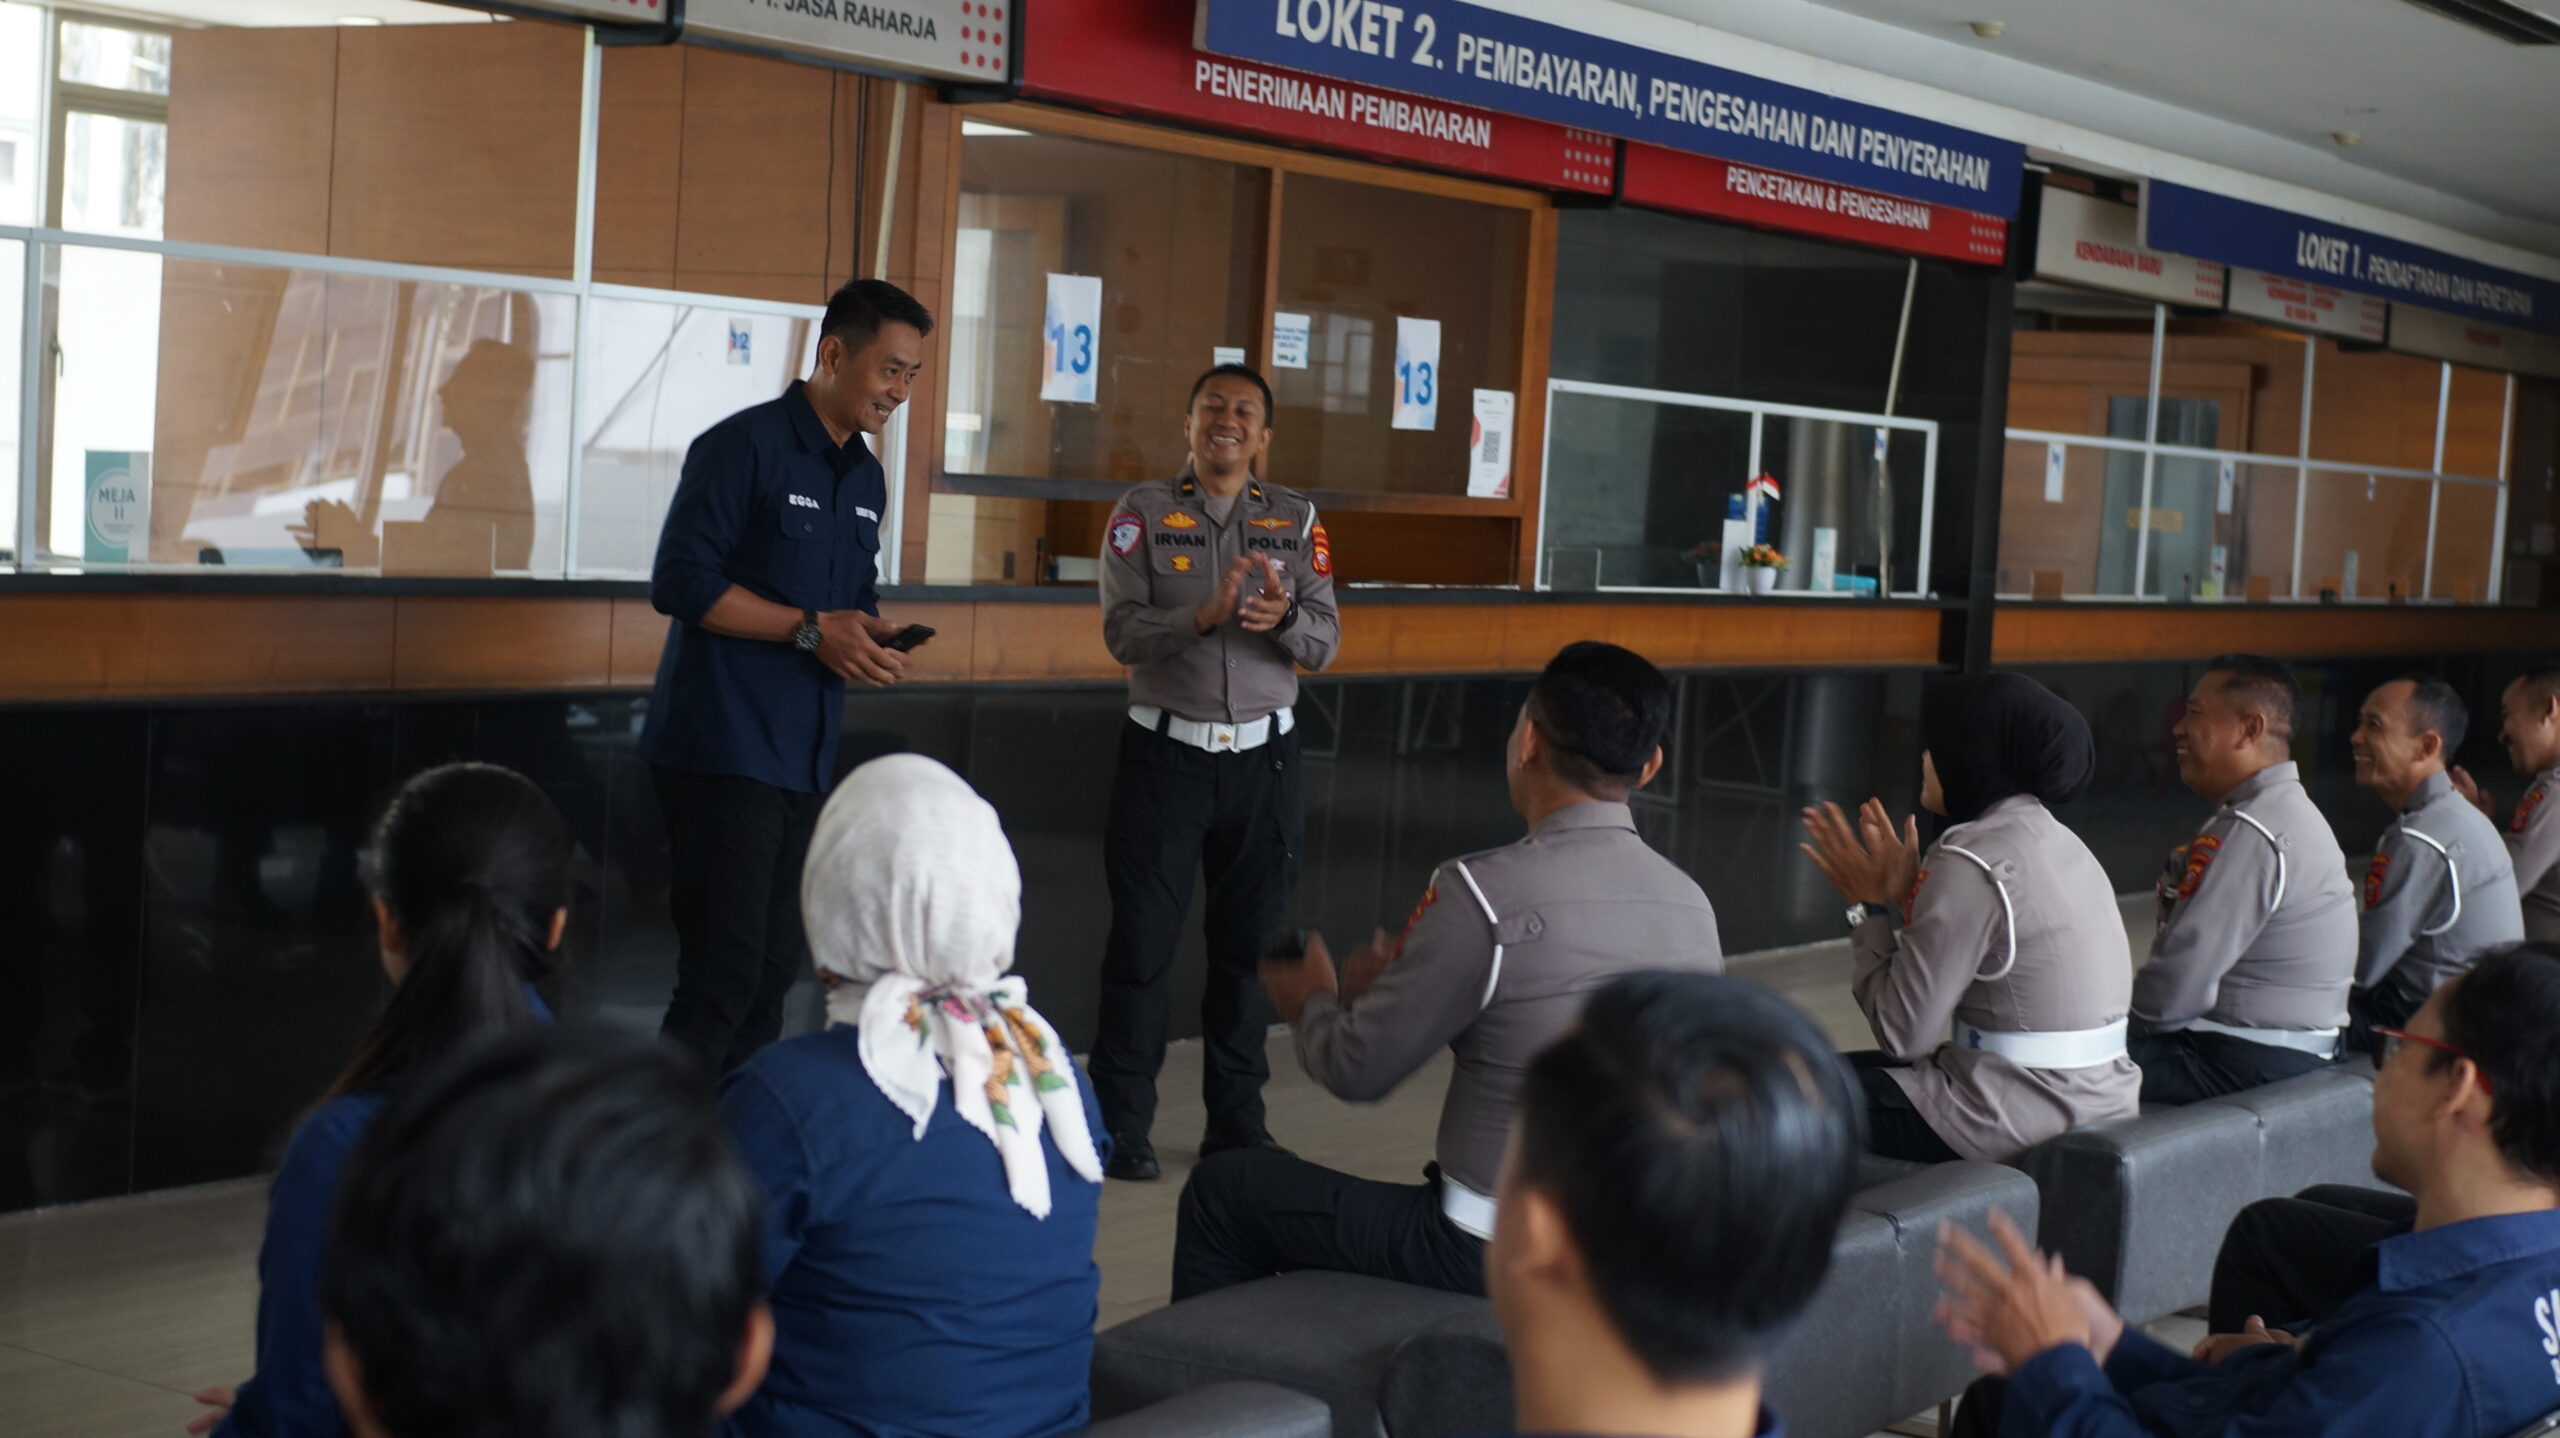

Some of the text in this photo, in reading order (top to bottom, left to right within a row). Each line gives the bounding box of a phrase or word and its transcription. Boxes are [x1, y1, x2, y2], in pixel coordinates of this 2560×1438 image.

[785, 0, 938, 42] JASA RAHARJA
[1195, 60, 1491, 149] PENERIMAAN PEMBAYARAN
[1276, 0, 1990, 192] LOKET 2. PEMBAYARAN, PENGESAHAN DAN PENYERAHAN
[1726, 166, 1930, 231] PENCETAKAN & PENGESAHAN
[2296, 230, 2349, 275] LOKET
[2353, 244, 2364, 280] 1.
[2367, 254, 2450, 299] PENDAFTARAN
[1050, 323, 1093, 375] 13
[1400, 361, 1433, 406] 13
[98, 487, 136, 504] MEJA
[1155, 533, 1206, 548] IRVAN
[1248, 536, 1298, 552] POLRI
